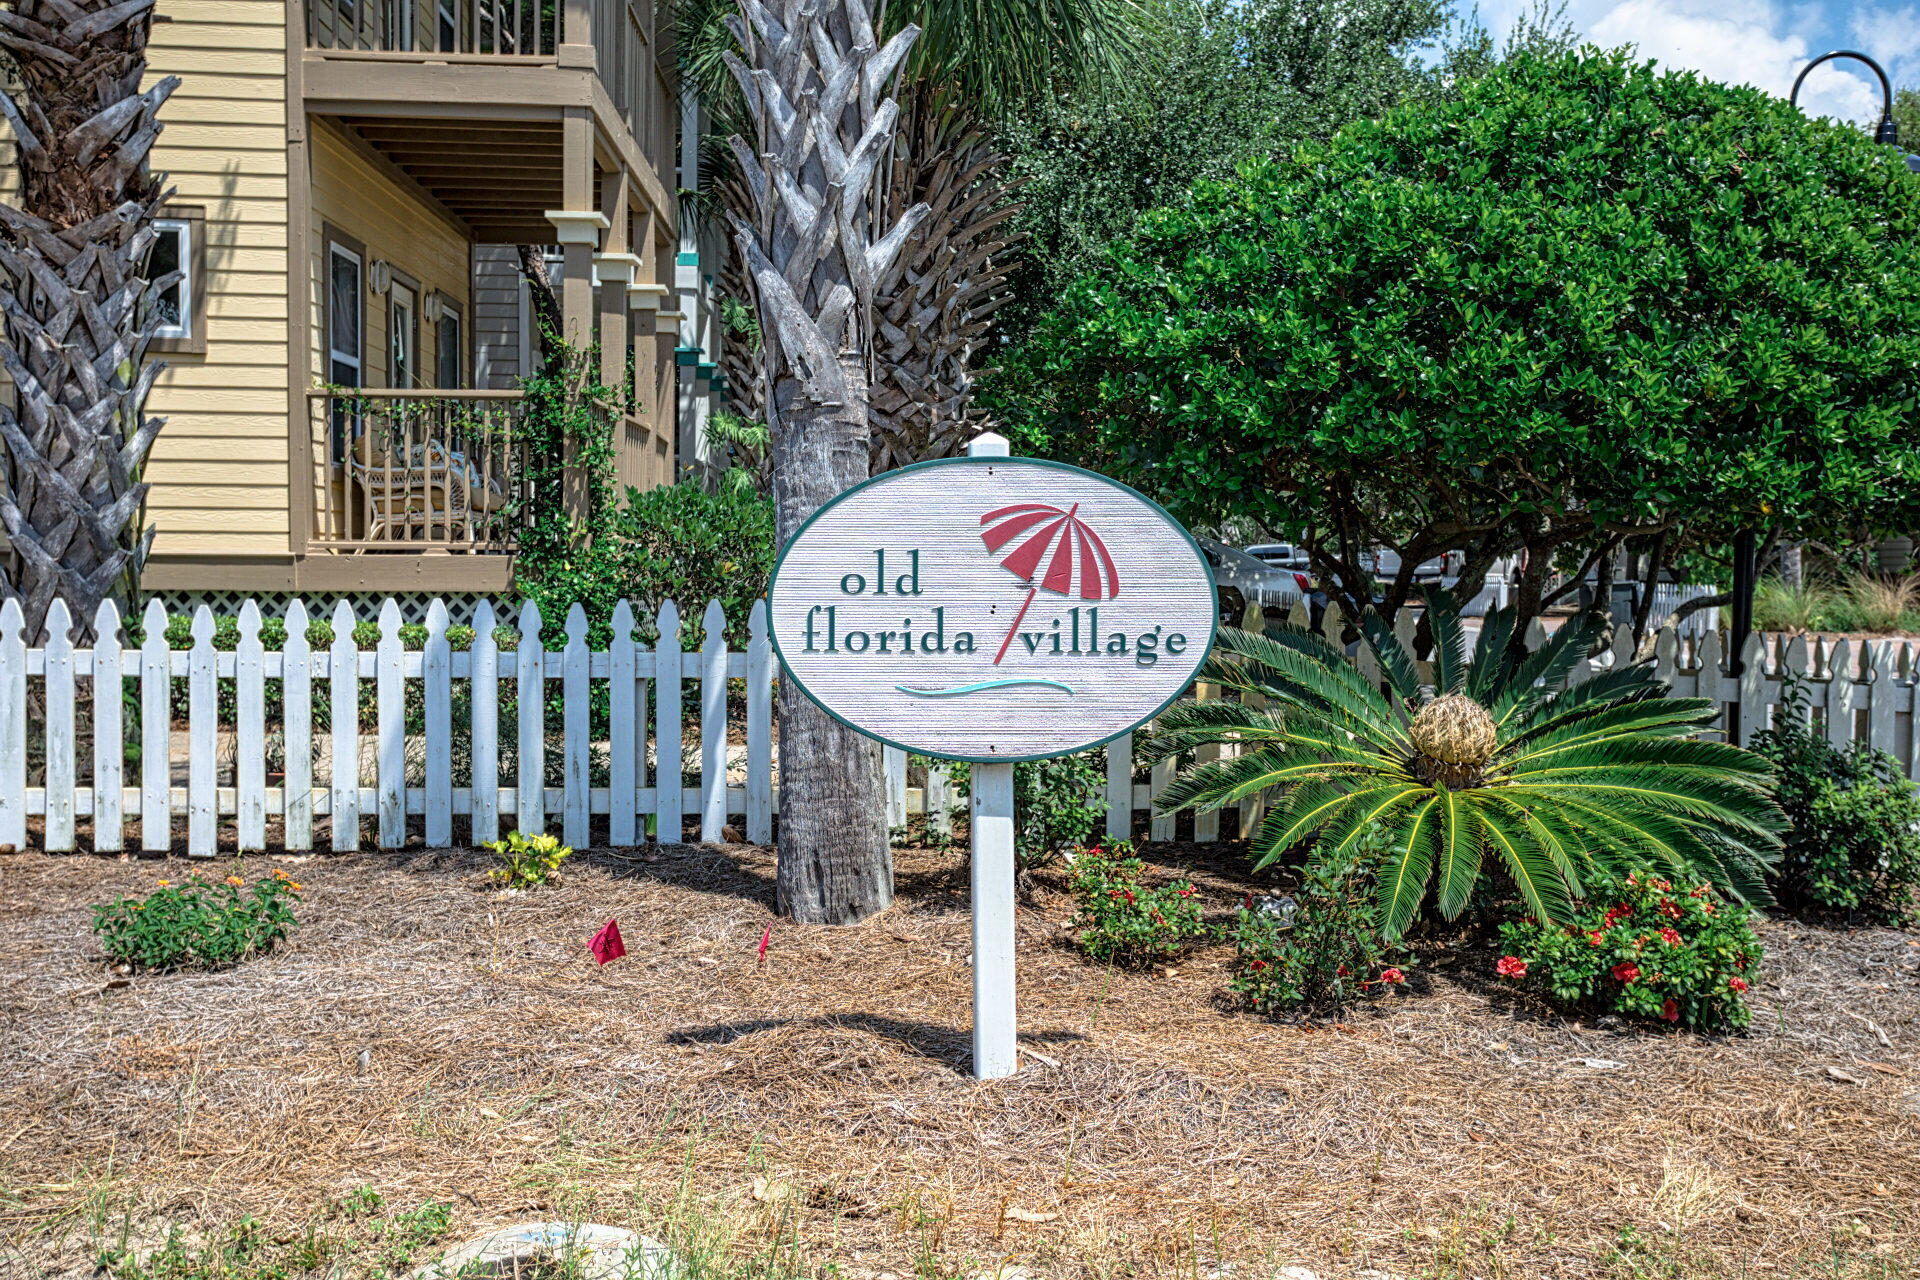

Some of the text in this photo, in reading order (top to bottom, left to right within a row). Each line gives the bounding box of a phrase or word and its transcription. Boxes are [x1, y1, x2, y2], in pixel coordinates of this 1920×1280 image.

[840, 548, 924, 596] old
[802, 604, 1187, 666] florida village
